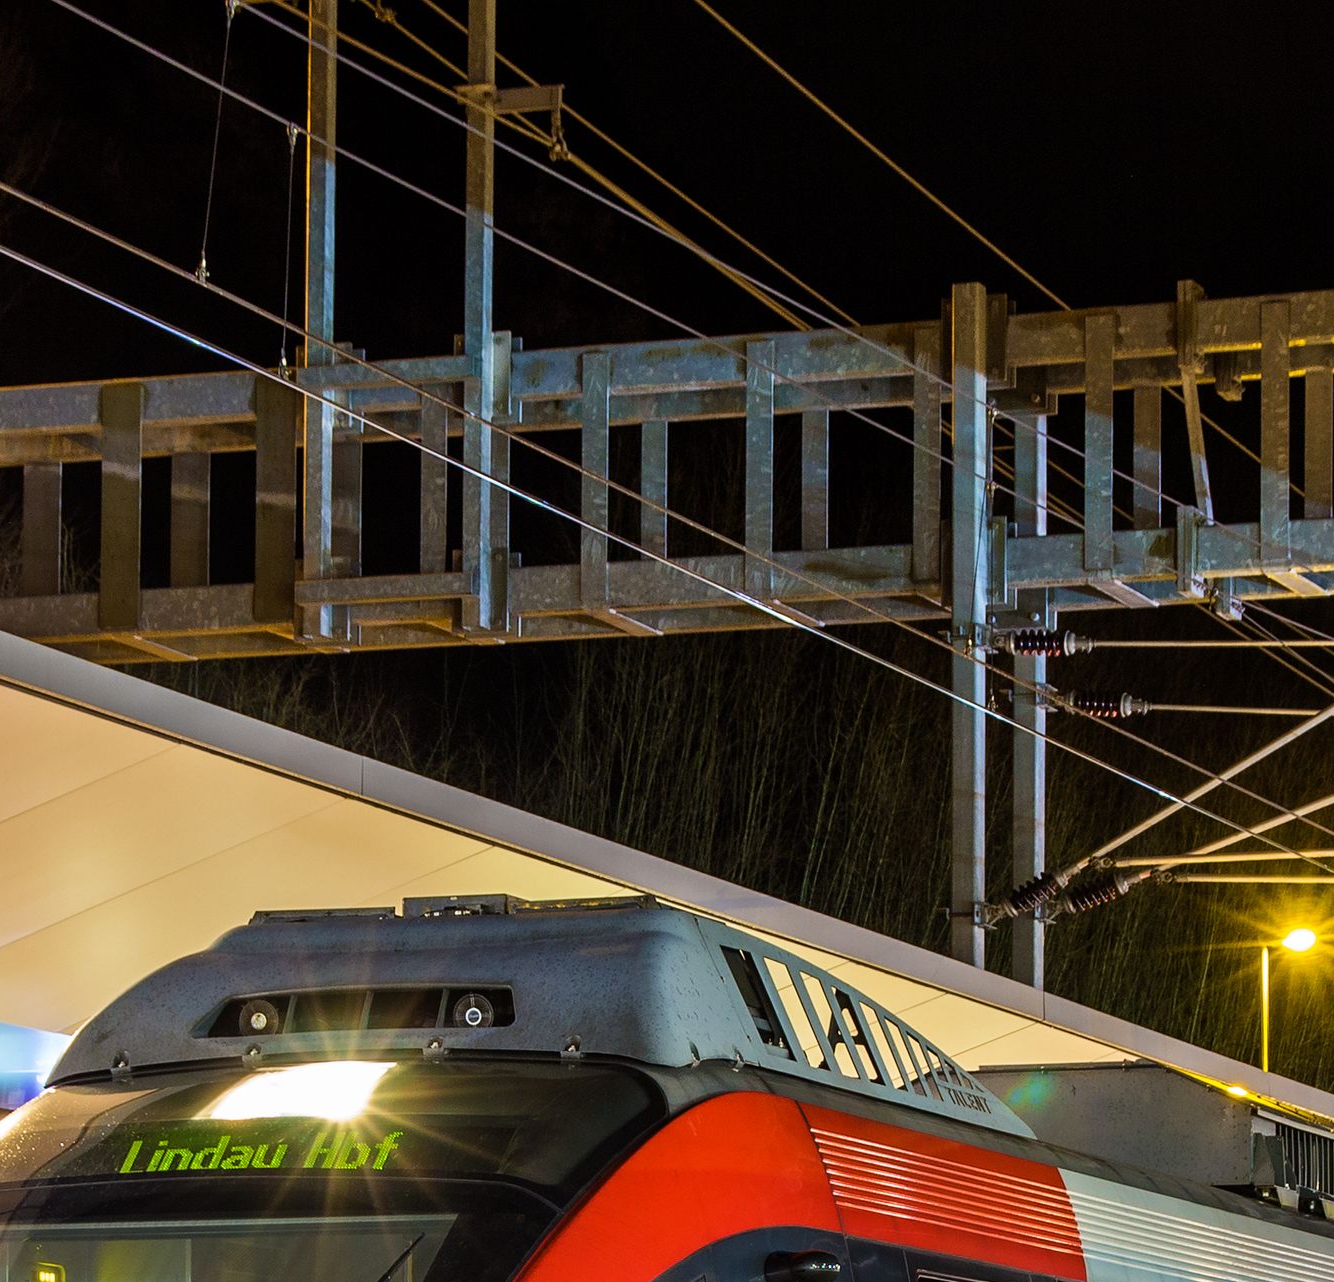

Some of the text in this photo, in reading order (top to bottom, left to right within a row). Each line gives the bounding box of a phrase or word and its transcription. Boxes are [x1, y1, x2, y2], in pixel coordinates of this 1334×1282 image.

[944, 1086, 992, 1114] TALENT
[119, 1131, 404, 1174] Lindau Hbf
